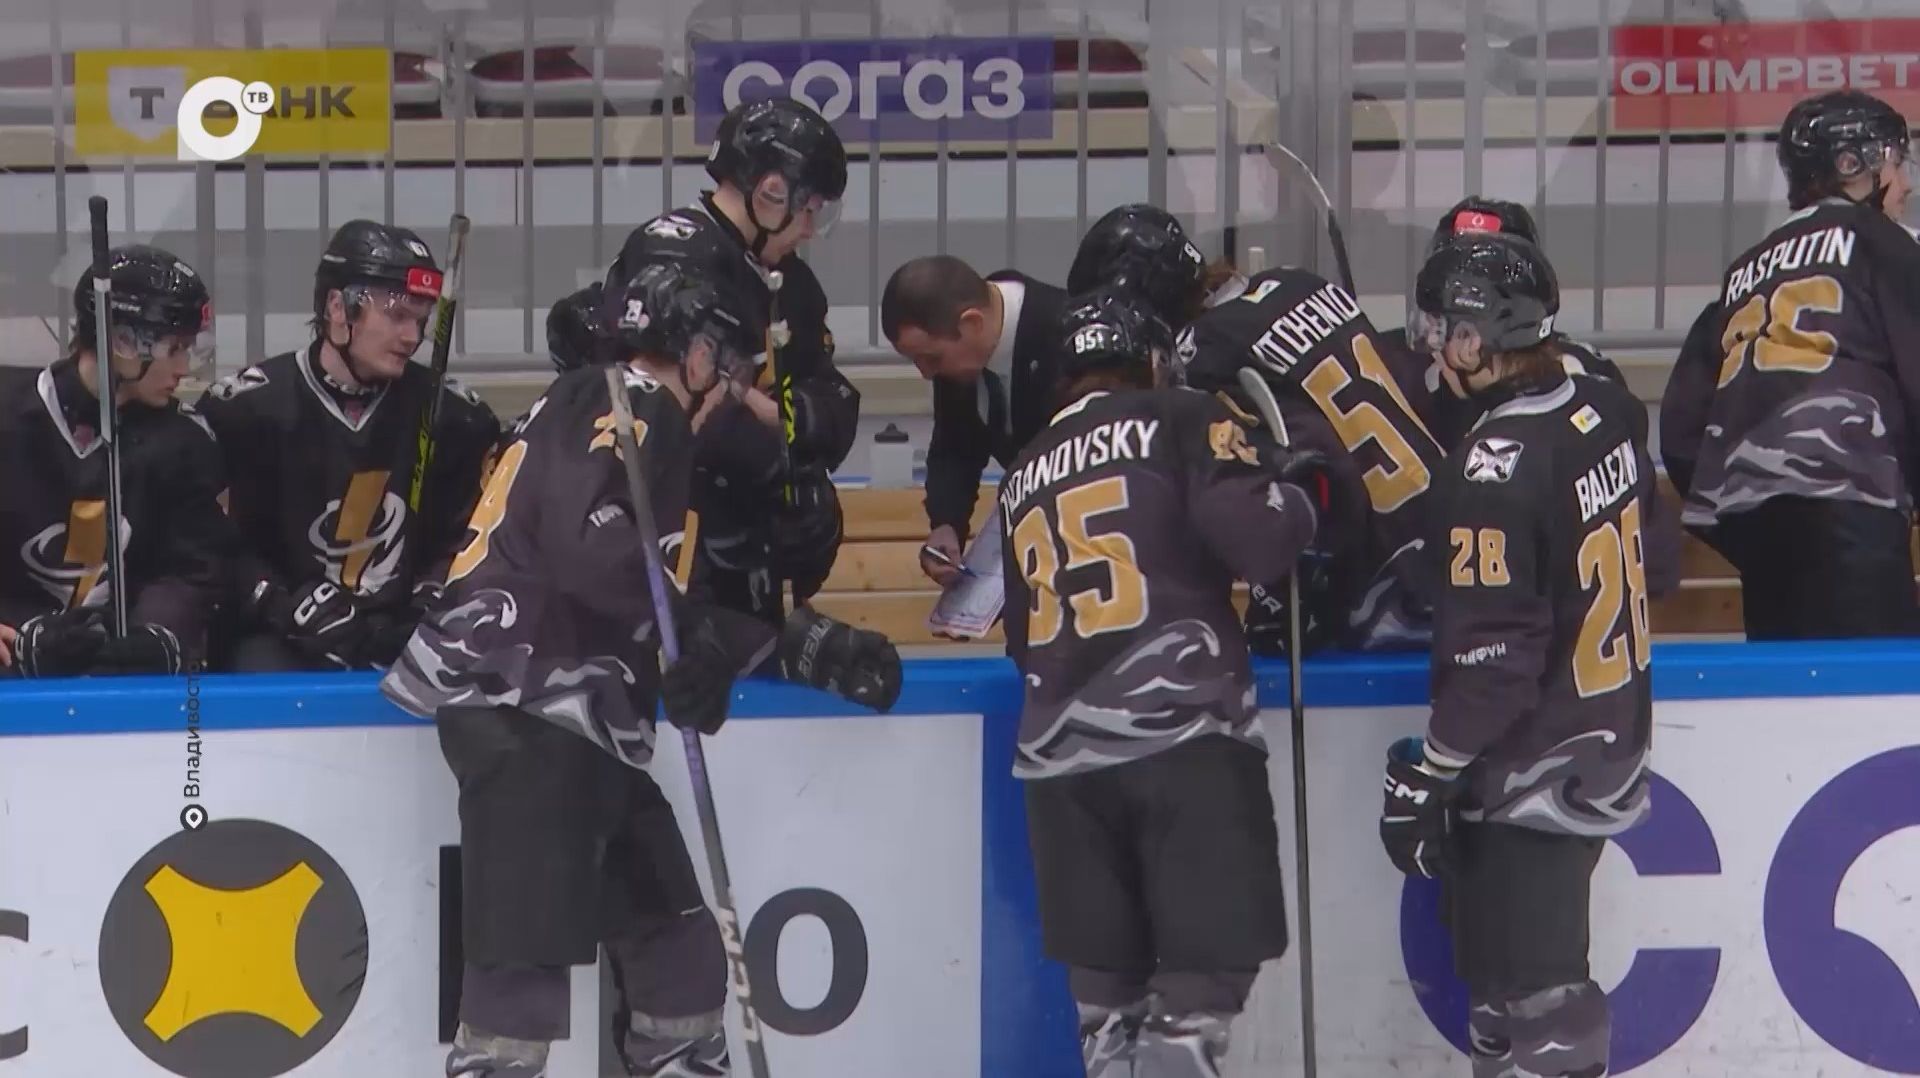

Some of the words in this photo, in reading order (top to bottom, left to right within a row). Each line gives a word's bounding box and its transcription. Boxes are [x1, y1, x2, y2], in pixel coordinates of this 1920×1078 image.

[1620, 53, 1920, 96] OLIMPBET
[1724, 225, 1857, 309] RASPUTIN
[1013, 475, 1150, 647] 95
[1450, 527, 1511, 587] 28
